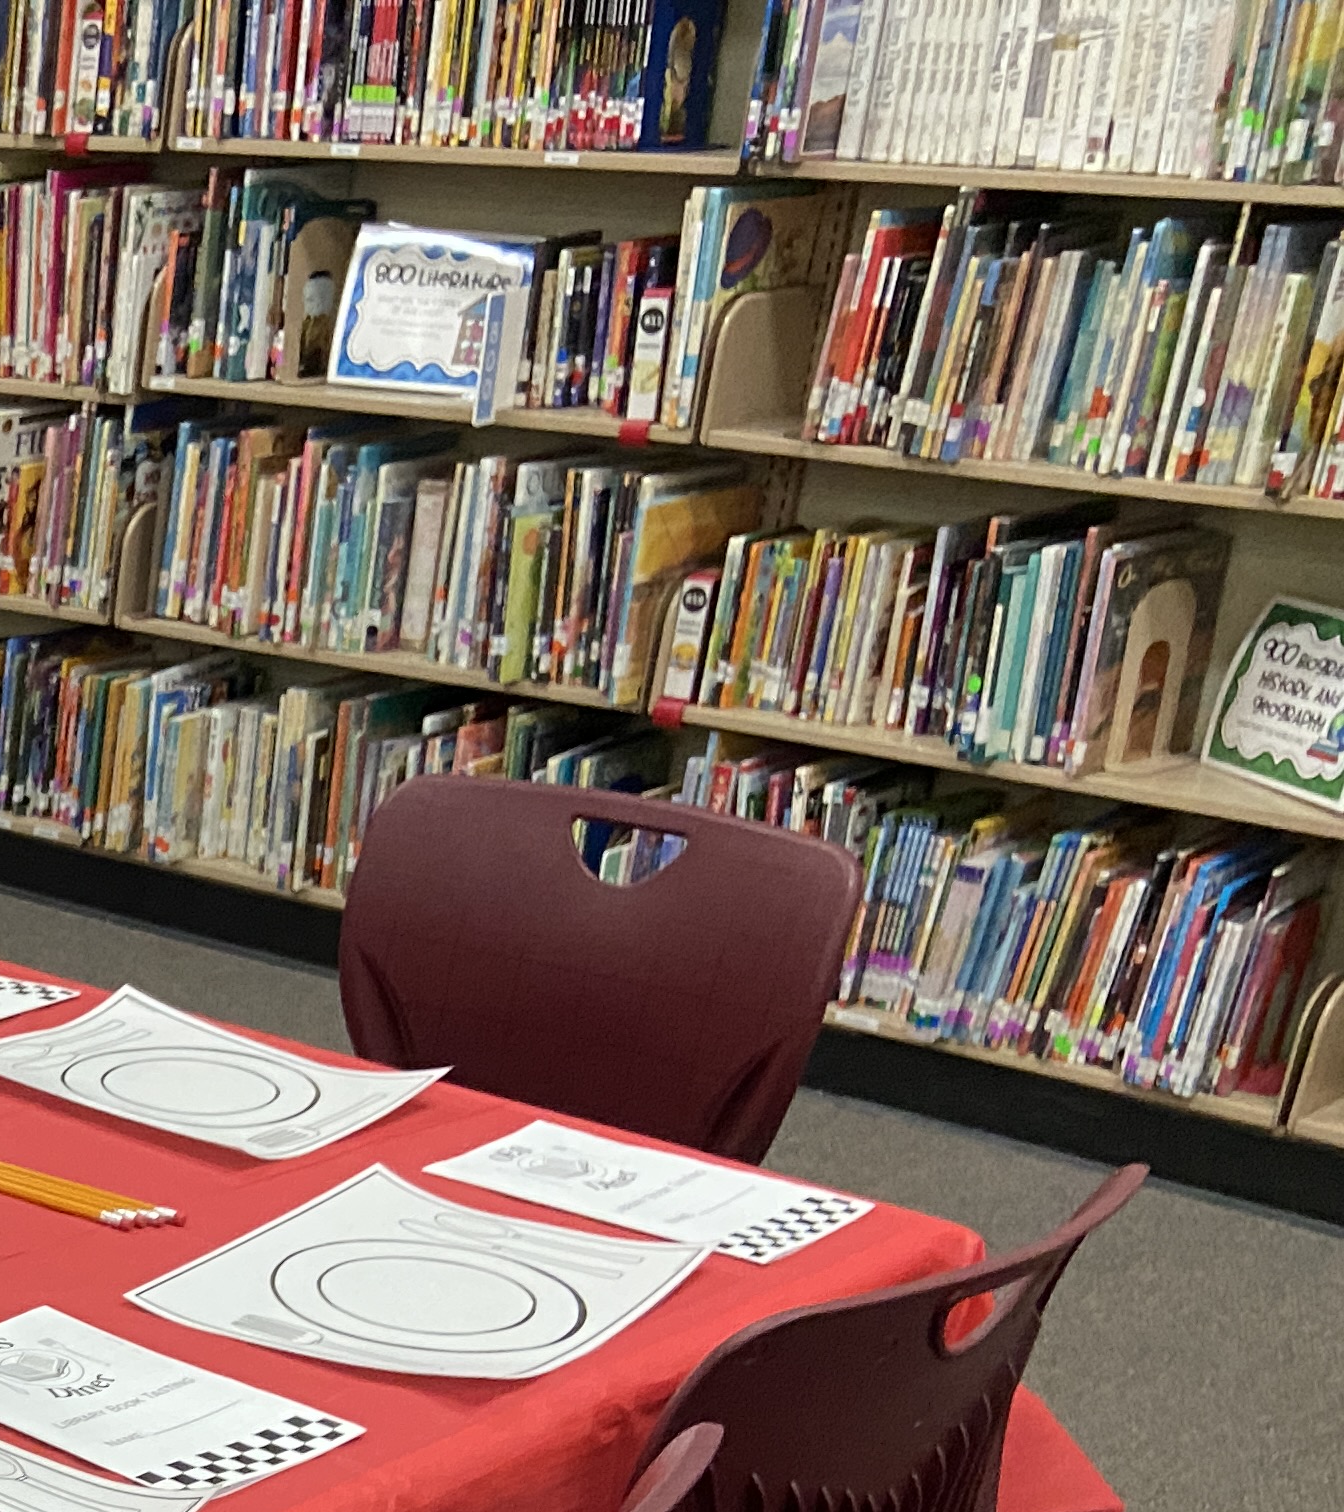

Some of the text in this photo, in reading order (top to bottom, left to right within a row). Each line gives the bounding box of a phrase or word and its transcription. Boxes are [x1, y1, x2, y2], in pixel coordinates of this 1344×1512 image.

[375, 262, 417, 286] 800
[1263, 637, 1301, 666] 900
[48, 1372, 116, 1400] Diner
[144, 1375, 197, 1400] TASTING
